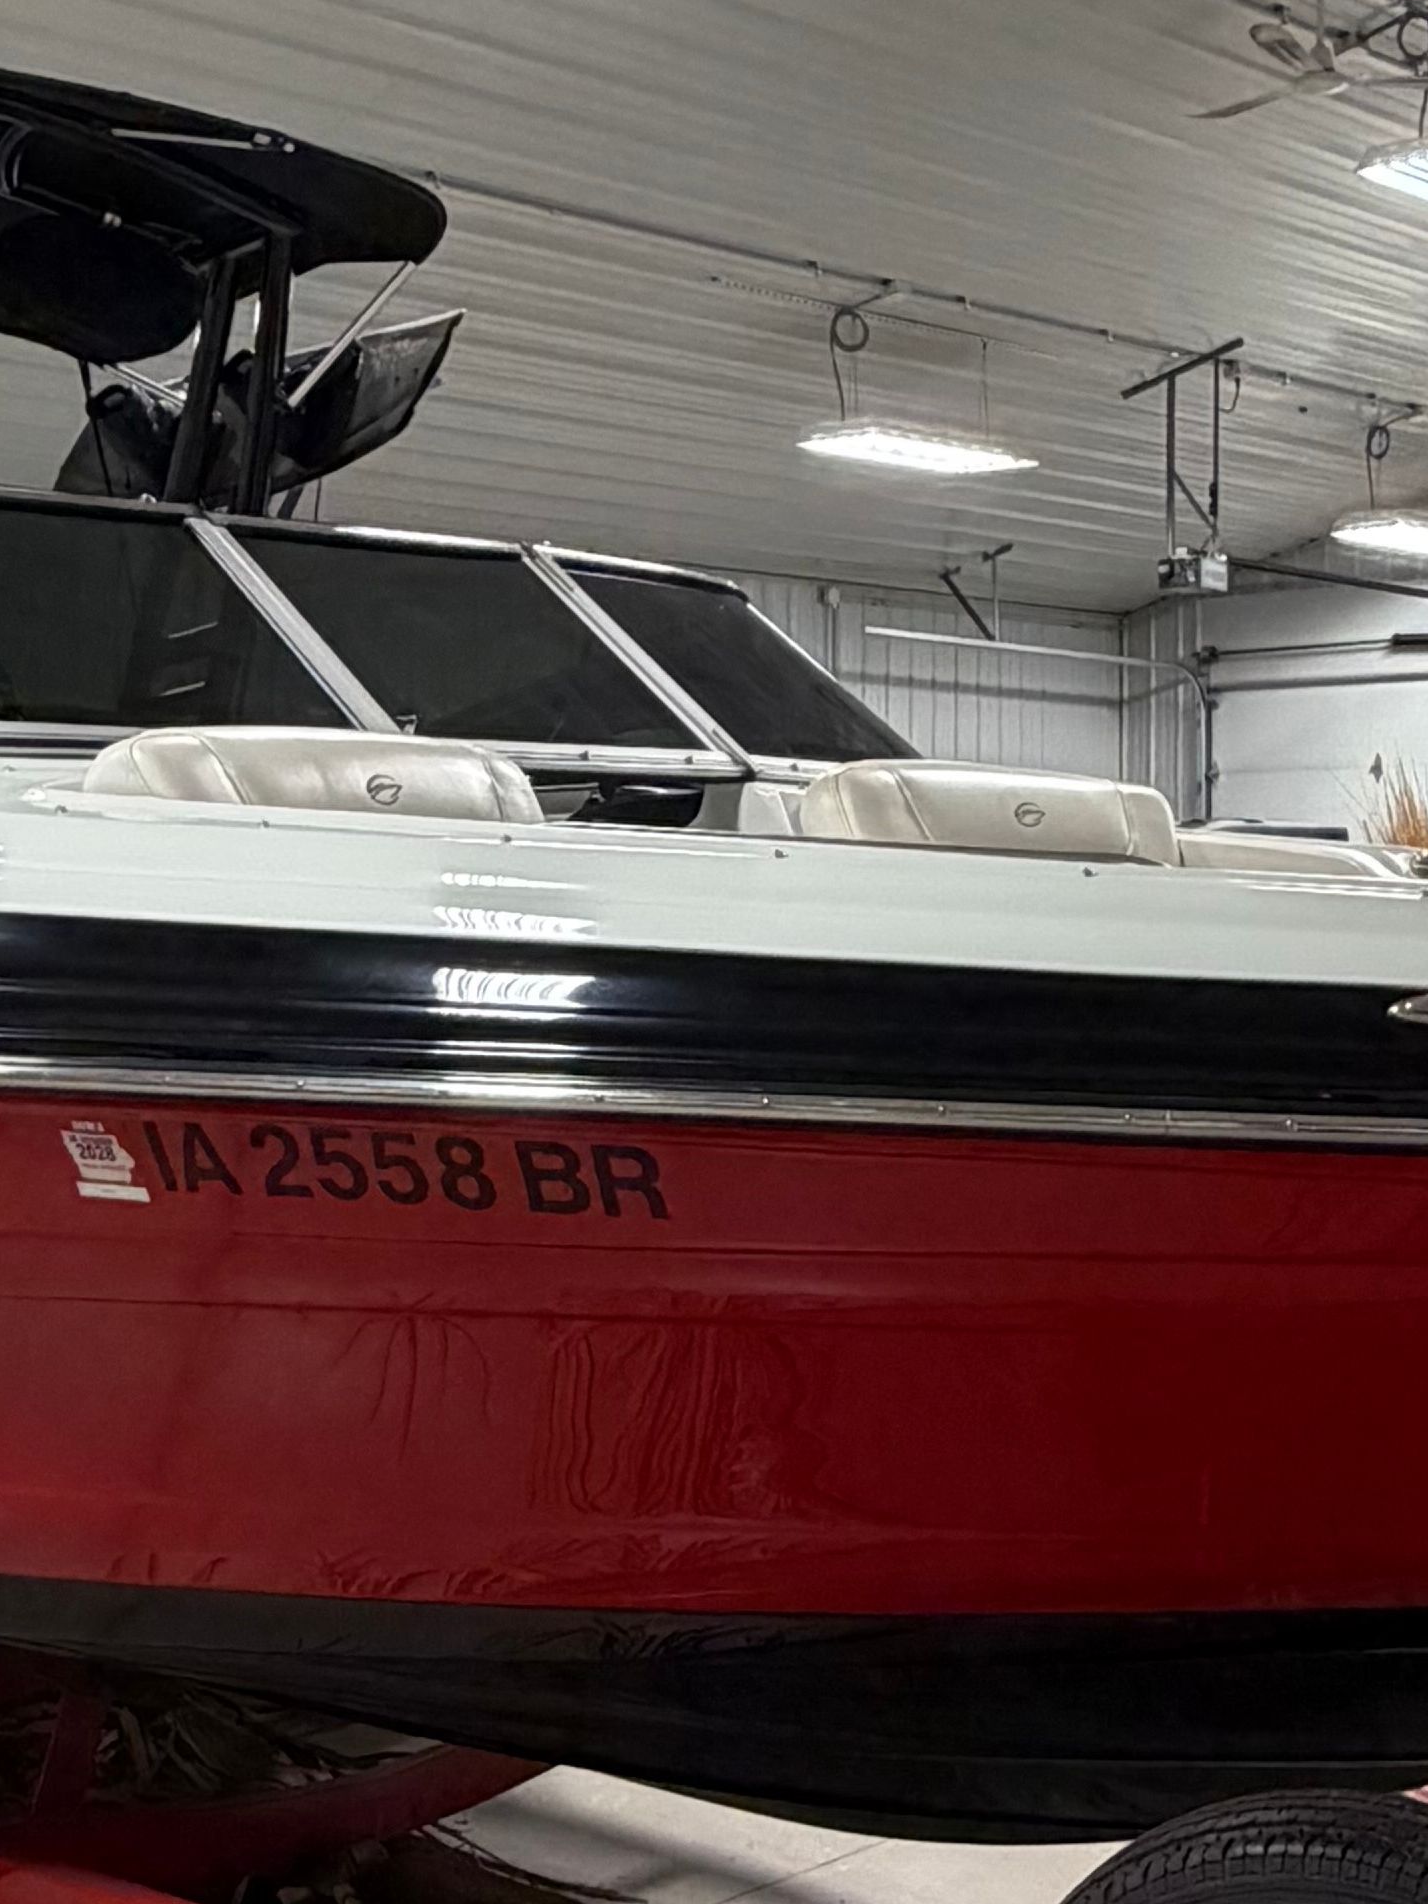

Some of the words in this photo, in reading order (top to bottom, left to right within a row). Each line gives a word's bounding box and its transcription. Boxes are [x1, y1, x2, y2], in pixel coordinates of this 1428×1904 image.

[142, 1120, 244, 1195] IA
[249, 1123, 497, 1212] 2558
[515, 1140, 669, 1220] BR
